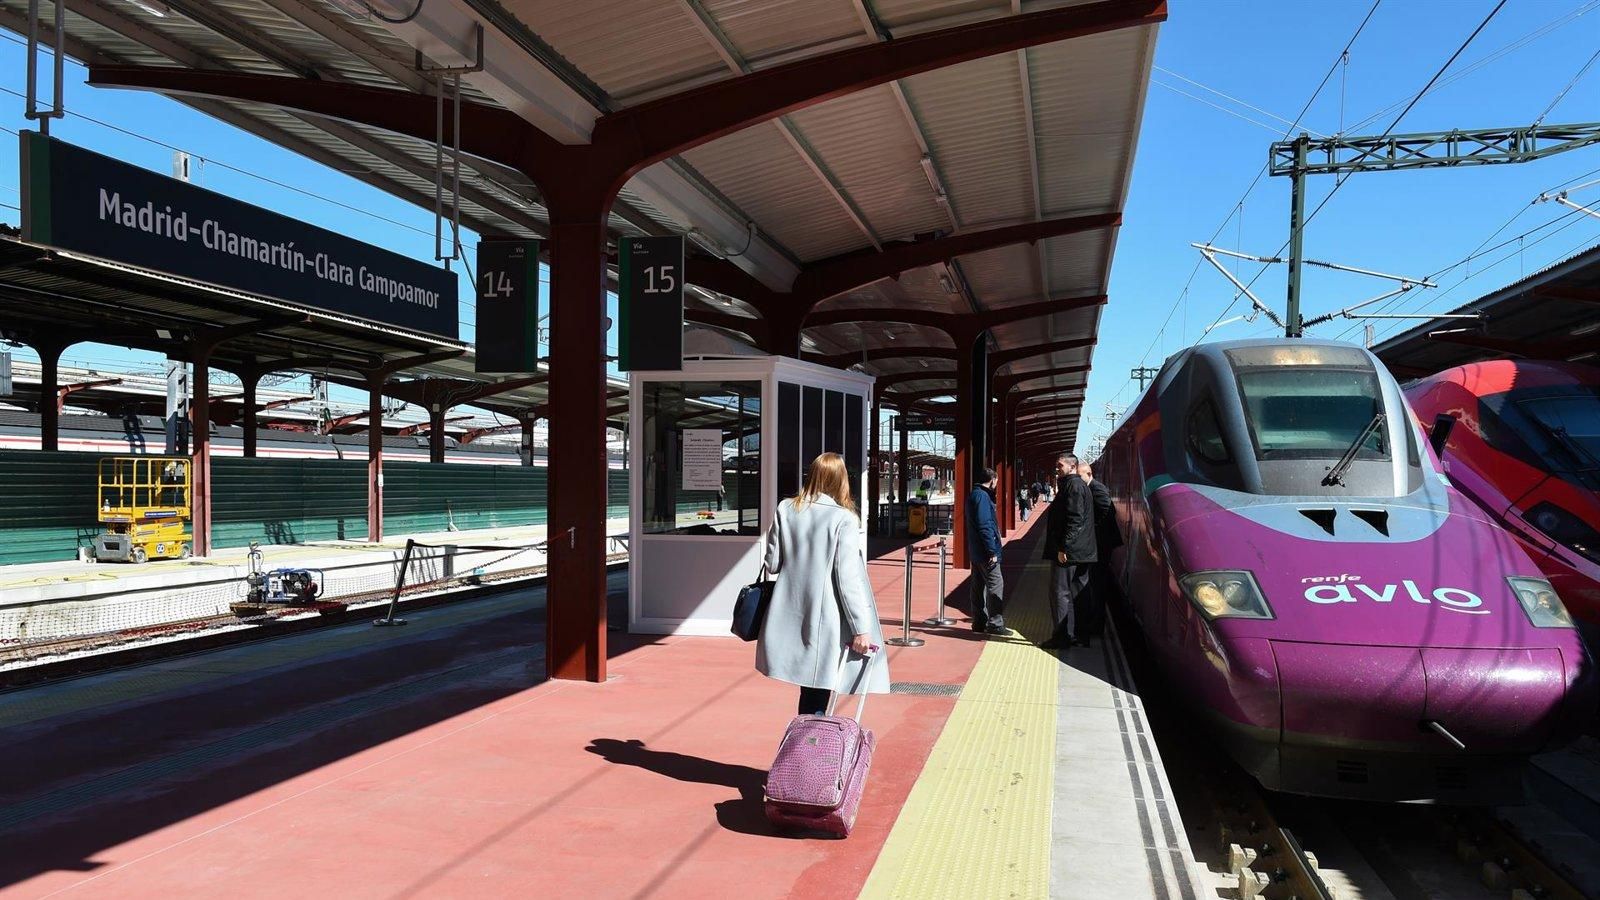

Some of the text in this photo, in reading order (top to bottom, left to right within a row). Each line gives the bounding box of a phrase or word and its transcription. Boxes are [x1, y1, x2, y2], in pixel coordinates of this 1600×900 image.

[99, 187, 440, 310] Madrid-Chamartín-Clara Campoamor
[483, 271, 514, 297] 14
[643, 265, 675, 293] 15
[1301, 573, 1362, 584] renfe
[1304, 580, 1483, 608] avlo
